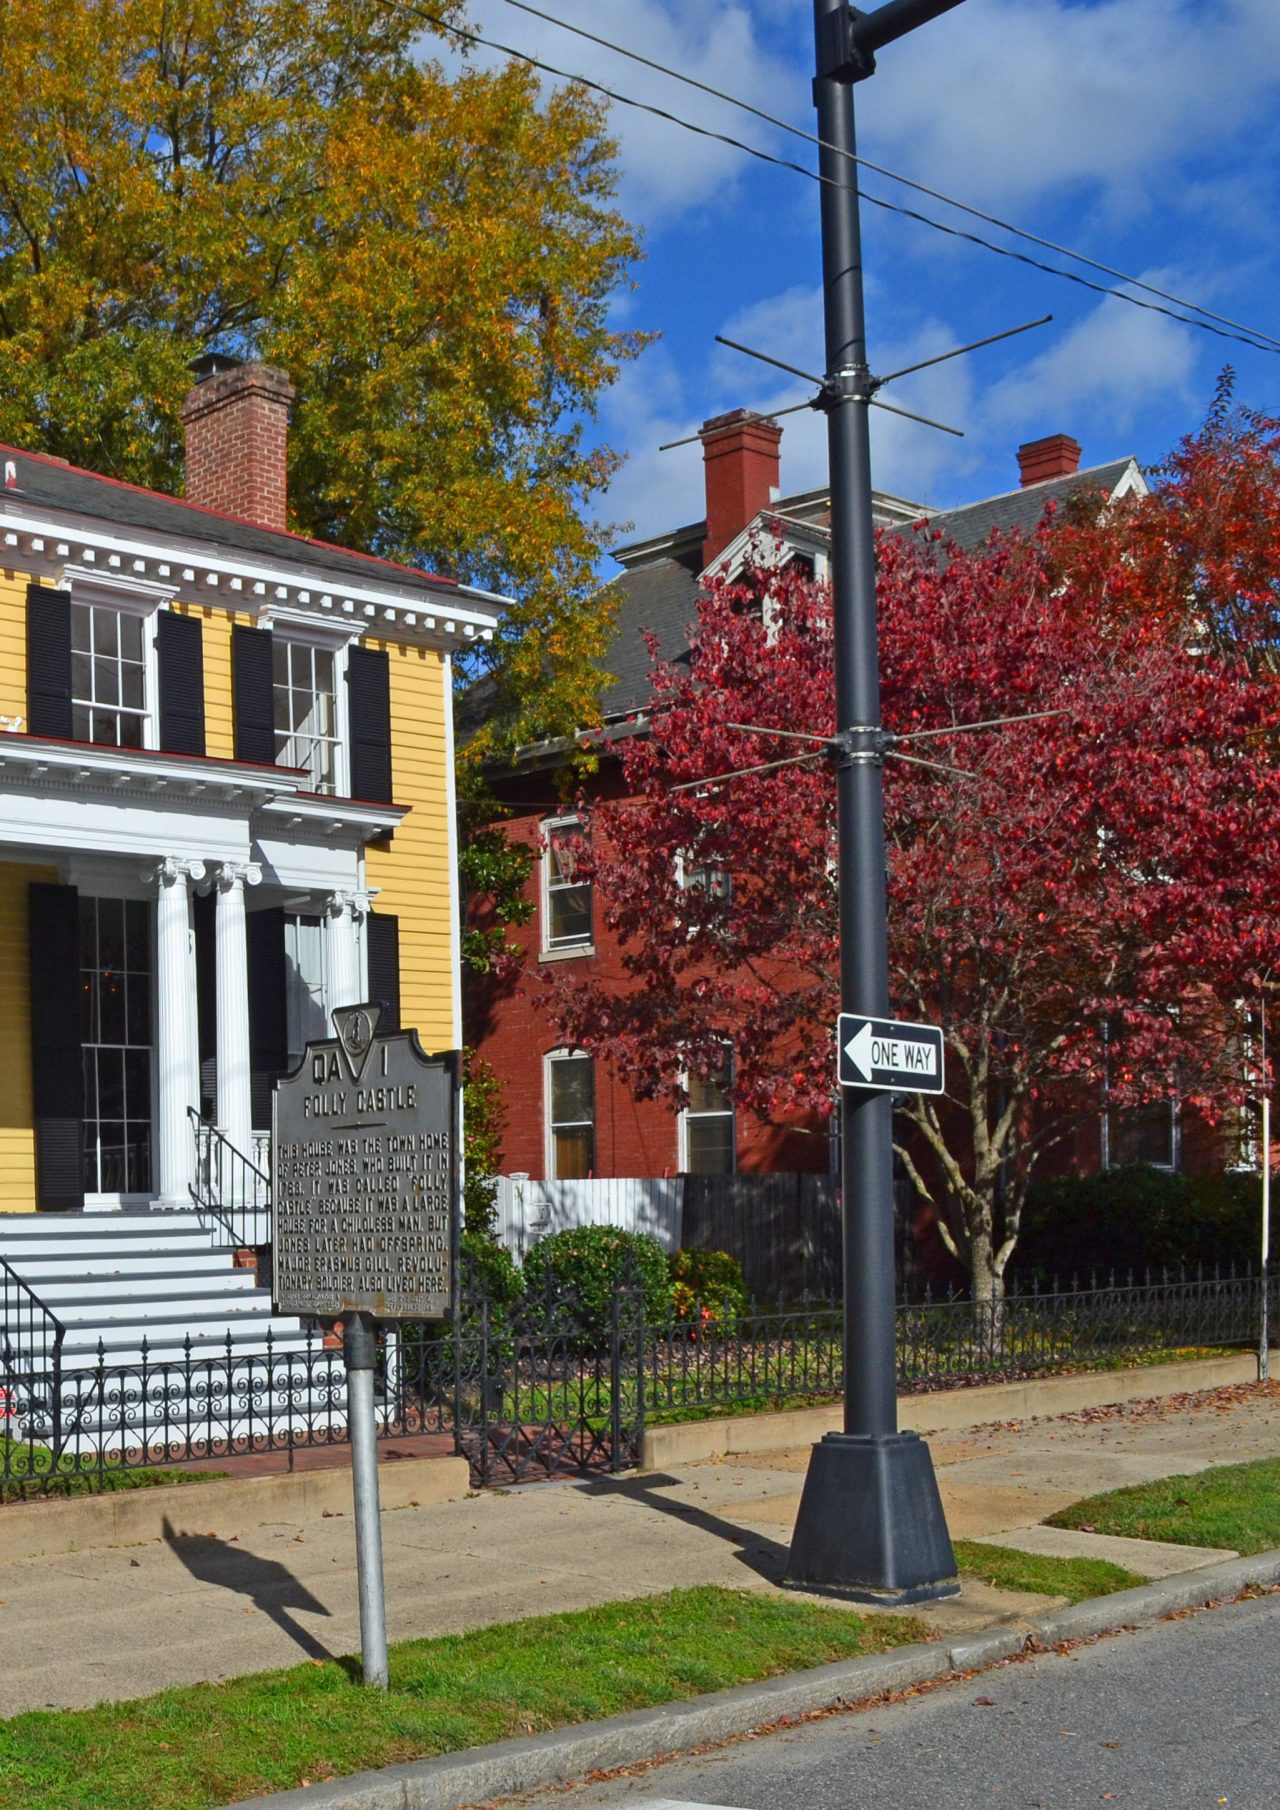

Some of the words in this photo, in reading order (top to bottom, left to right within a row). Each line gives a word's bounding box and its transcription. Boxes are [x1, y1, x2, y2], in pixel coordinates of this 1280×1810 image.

[871, 1040, 899, 1067] ONE
[904, 1044, 932, 1071] WAY
[312, 1051, 343, 1085] QA
[304, 1091, 346, 1118] FOLLY
[357, 1085, 418, 1113] CASTLE
[278, 1144, 299, 1159] THIS
[302, 1140, 334, 1158] HOUSE
[338, 1139, 358, 1156] WAS
[363, 1137, 382, 1154] THE
[387, 1134, 415, 1152] TOWN
[420, 1132, 449, 1150] HOME
[278, 1162, 289, 1178] OF
[293, 1160, 322, 1178] PETER
[363, 1157, 384, 1174] WHO
[388, 1154, 418, 1172] BUILT
[423, 1153, 433, 1171] IT
[438, 1152, 449, 1170] IN
[311, 1179, 321, 1196] IT
[328, 1178, 350, 1196] WAS
[356, 1175, 400, 1193] CALLED
[319, 1197, 361, 1215] BECAUSE
[365, 1196, 374, 1213] IT
[377, 1196, 398, 1212] WAS
[402, 1195, 410, 1212] A
[413, 1194, 449, 1211] LARGE
[278, 1218, 306, 1234] HOUSE
[309, 1218, 327, 1233] FOR
[331, 1217, 338, 1233] A
[342, 1216, 395, 1233] CHILDLESS
[428, 1214, 449, 1231] BUT
[278, 1237, 310, 1253] JONES
[315, 1236, 347, 1253] LATER
[353, 1236, 374, 1252] HAD
[381, 1235, 448, 1252] OFFSPRING.
[278, 1256, 311, 1272] MAJOR
[315, 1256, 361, 1272] ERASMUS
[398, 1255, 448, 1273] REVOLU-
[278, 1275, 312, 1290] TIONARY
[359, 1275, 384, 1292] ALSO
[387, 1276, 416, 1292] LIVED
[419, 1276, 448, 1293] HERE.
